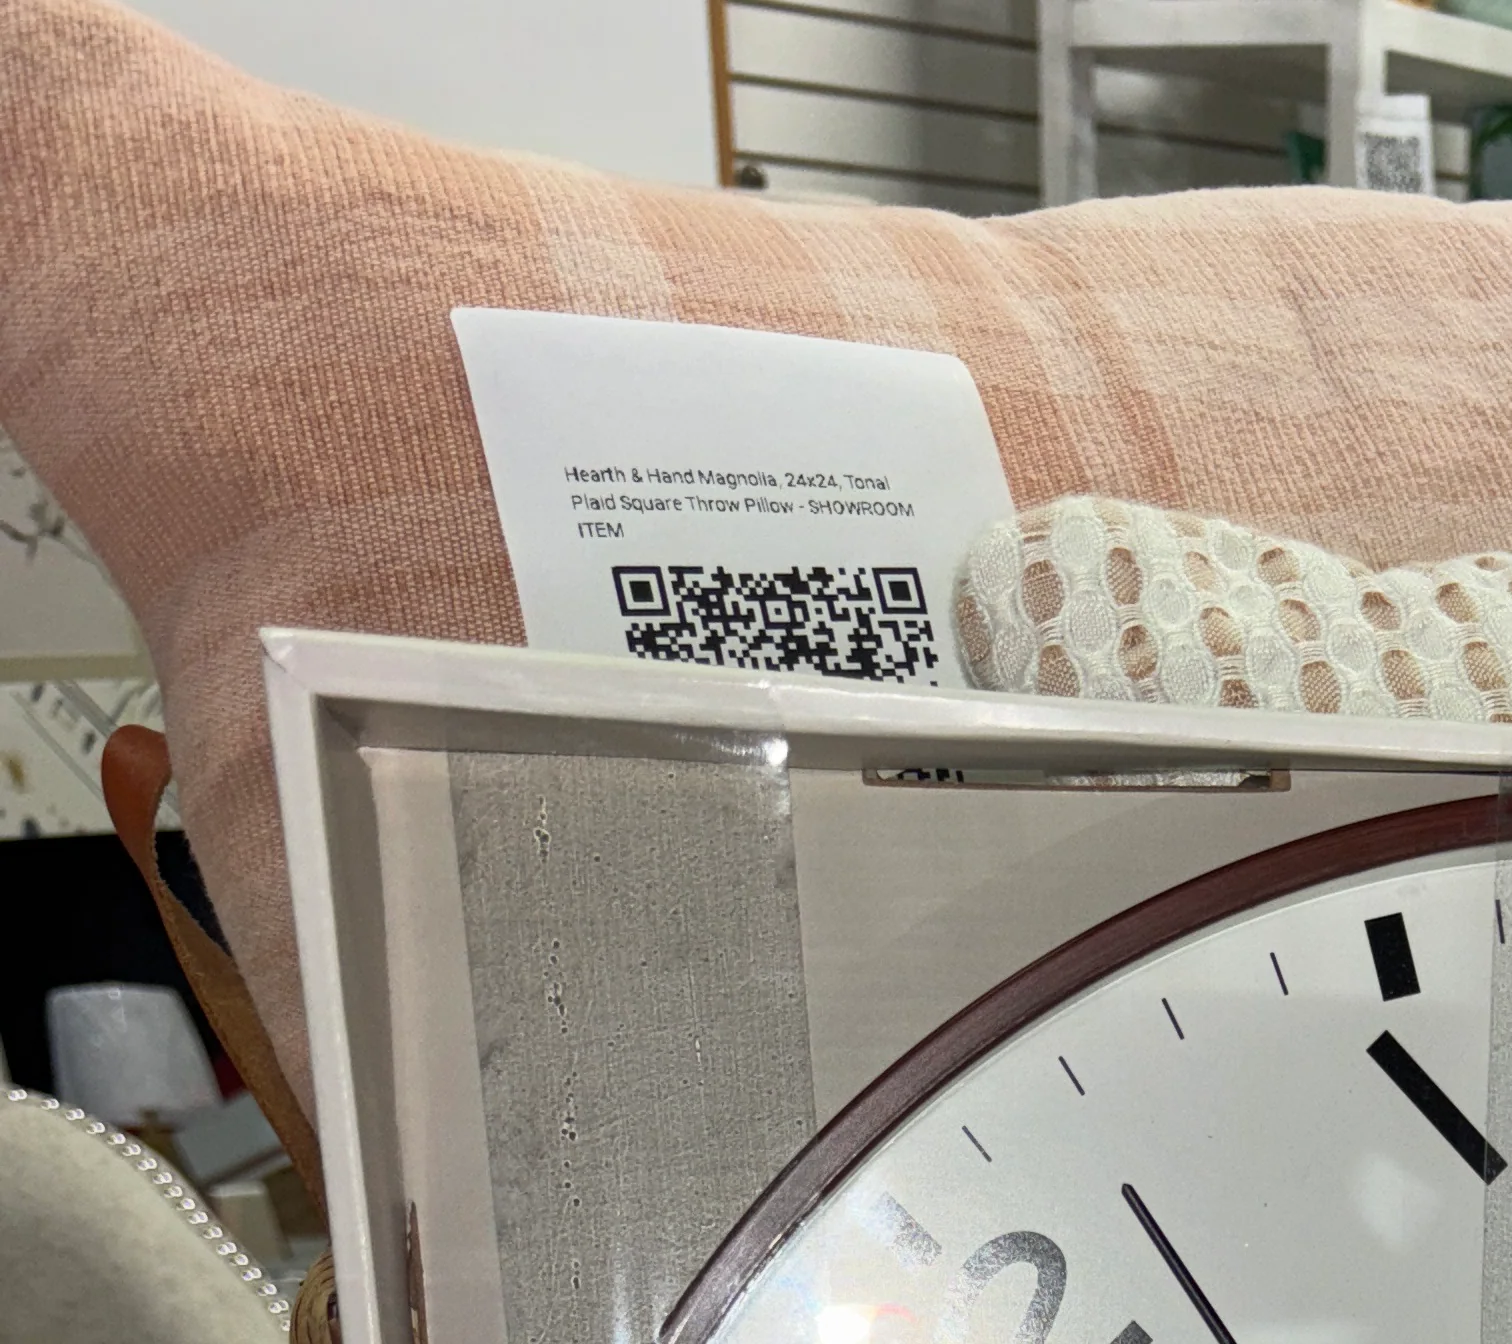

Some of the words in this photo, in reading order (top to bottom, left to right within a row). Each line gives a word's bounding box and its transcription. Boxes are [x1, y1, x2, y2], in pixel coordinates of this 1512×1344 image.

[564, 466, 626, 484] Hearth
[631, 467, 644, 484] &
[646, 468, 695, 485] Hand
[698, 470, 783, 490] Magnolia,
[785, 472, 843, 492] 24x24,
[843, 474, 890, 491] Tonal
[571, 493, 617, 511] Plaid
[620, 494, 683, 515] Square
[685, 495, 740, 513] Throw
[744, 497, 794, 514] Pillow
[808, 499, 915, 518] SHOWROOM
[577, 521, 625, 539] ITEM
[1367, 1030, 1507, 1185] 1
